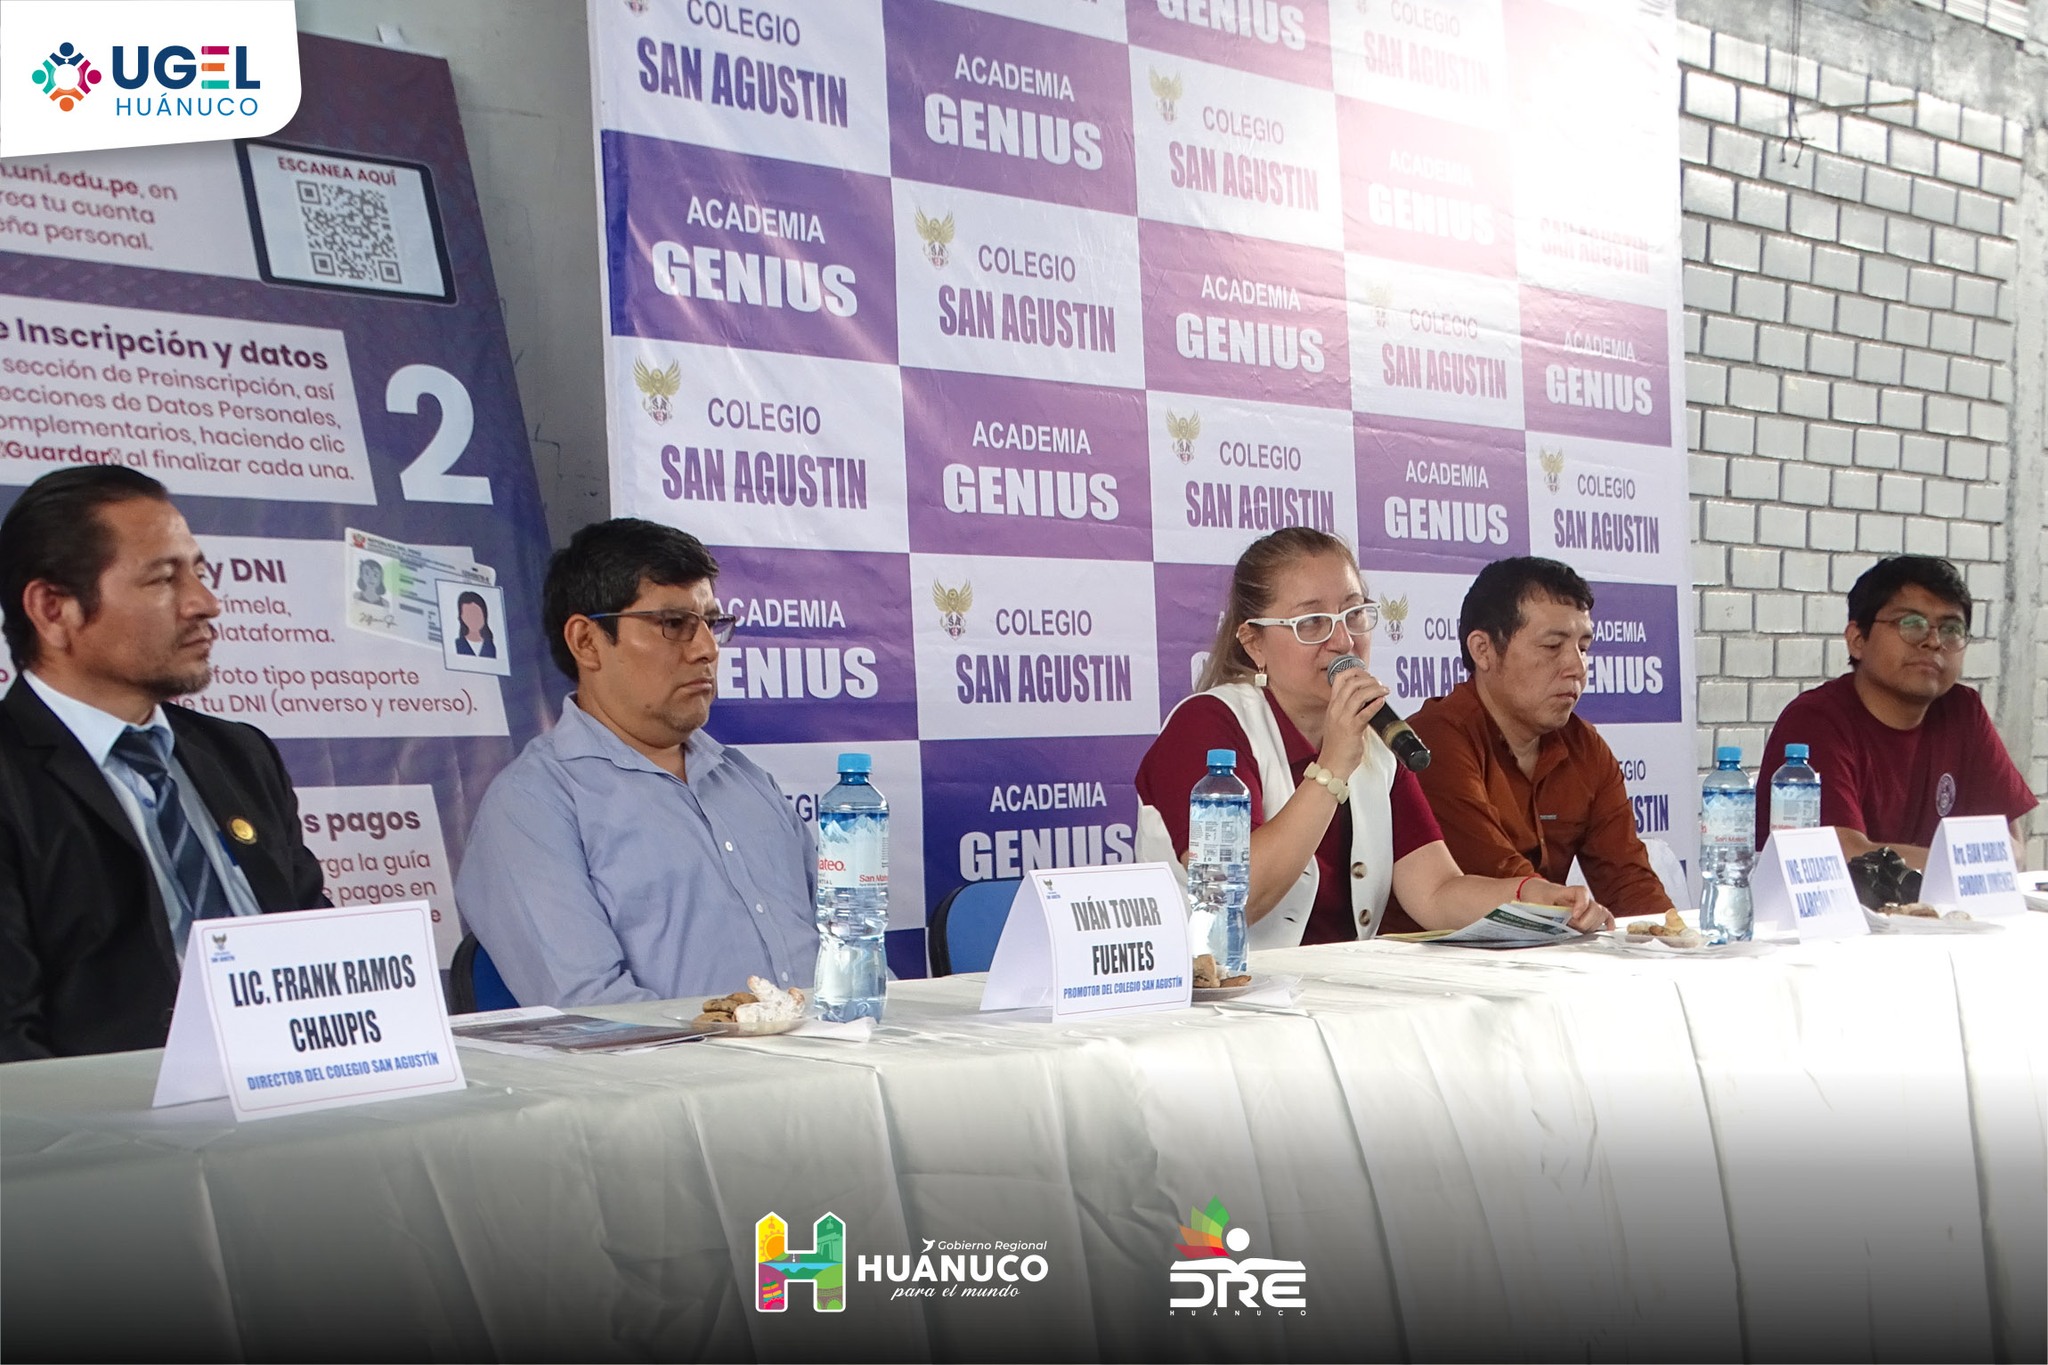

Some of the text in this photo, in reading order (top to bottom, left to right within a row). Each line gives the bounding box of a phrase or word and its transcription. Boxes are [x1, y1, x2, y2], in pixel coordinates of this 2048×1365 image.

[687, 0, 800, 46] COLEGIO
[1364, 30, 1404, 78] SAN
[636, 37, 849, 128] SAN AGUSTIN
[954, 53, 1075, 102] ACADEMIA
[924, 92, 1103, 171] GENIUS
[1202, 106, 1285, 145] COLEGIO
[277, 156, 397, 186] ESCANEA AQUÍ
[1169, 141, 1319, 212] SAN AGUSTIN
[1389, 150, 1473, 185] ACADEMIA
[42, 194, 67, 212] tu
[72, 200, 155, 224] cuenta
[148, 184, 178, 200] en
[686, 195, 826, 244] ACADEMIA
[1369, 183, 1495, 246] GENIUS
[44, 223, 154, 250] personal.
[651, 240, 858, 318] GENIUS
[977, 244, 1077, 283] COLEGIO
[1201, 274, 1301, 312] ACADEMIA
[938, 285, 1117, 353] SAN AGUSTIN
[1409, 308, 1478, 341] COLEGIO
[16, 318, 208, 360] Inscripción
[213, 342, 232, 369] y
[240, 340, 329, 370] datos
[1176, 312, 1325, 374] GENIUS
[1563, 331, 1637, 362] ACADEMIA
[2, 358, 335, 400] sección de Preinscripción, así
[1382, 342, 1508, 400] SAN AGUSTIN
[1546, 365, 1653, 415] GENIUS
[112, 393, 141, 411] de
[147, 395, 213, 417] Datos
[219, 400, 341, 429] Personales,
[707, 397, 821, 436] COLEGIO
[199, 426, 304, 450] haciendo
[310, 435, 345, 453] clic
[385, 363, 493, 505] 2
[972, 421, 1092, 455] ACADEMIA
[127, 449, 148, 467] al
[153, 449, 241, 472] finalizar
[247, 459, 304, 477] cada
[308, 464, 354, 480] una.
[1219, 441, 1302, 471] COLEGIO
[1405, 460, 1489, 490] ACADEMIA
[661, 444, 868, 510] SAN AGUSTIN
[943, 464, 1120, 521] GENIUS
[1577, 473, 1637, 501] COLEGIO
[1185, 480, 1335, 533] SAN AGUSTIN
[1384, 496, 1509, 545] GENIUS
[1553, 508, 1660, 554] SAN AGUSTIN
[230, 558, 287, 583] DNI
[996, 608, 1093, 637] COLEGIO
[212, 665, 419, 690] foto tipo pasaporte
[956, 653, 1132, 704] SAN AGUSTIN
[1396, 655, 1435, 699] SAN
[200, 695, 224, 712] tu
[229, 695, 267, 712] DNI
[271, 689, 368, 716] (anverso
[373, 697, 385, 715] y
[389, 689, 478, 715] reverso).
[990, 781, 1107, 813] ACADEMIA
[326, 810, 421, 841] pagos
[358, 853, 378, 871] la
[384, 850, 431, 876] guía
[959, 823, 1134, 882] GENIUS
[338, 883, 406, 906] pagos
[410, 880, 437, 896] en
[1070, 896, 1162, 931] IVÁN TOVAR
[1092, 940, 1155, 976] FUENTES
[228, 954, 416, 1008] LIC. FRANK RAMOS
[1063, 975, 1183, 999] PROMOTOR DEL COLEGIO SAN AGUSTÍN
[289, 1009, 382, 1053] CHAUPIS
[247, 1050, 439, 1091] DIRECTOR DEL COLEGIO SAN AGUSTÍN
